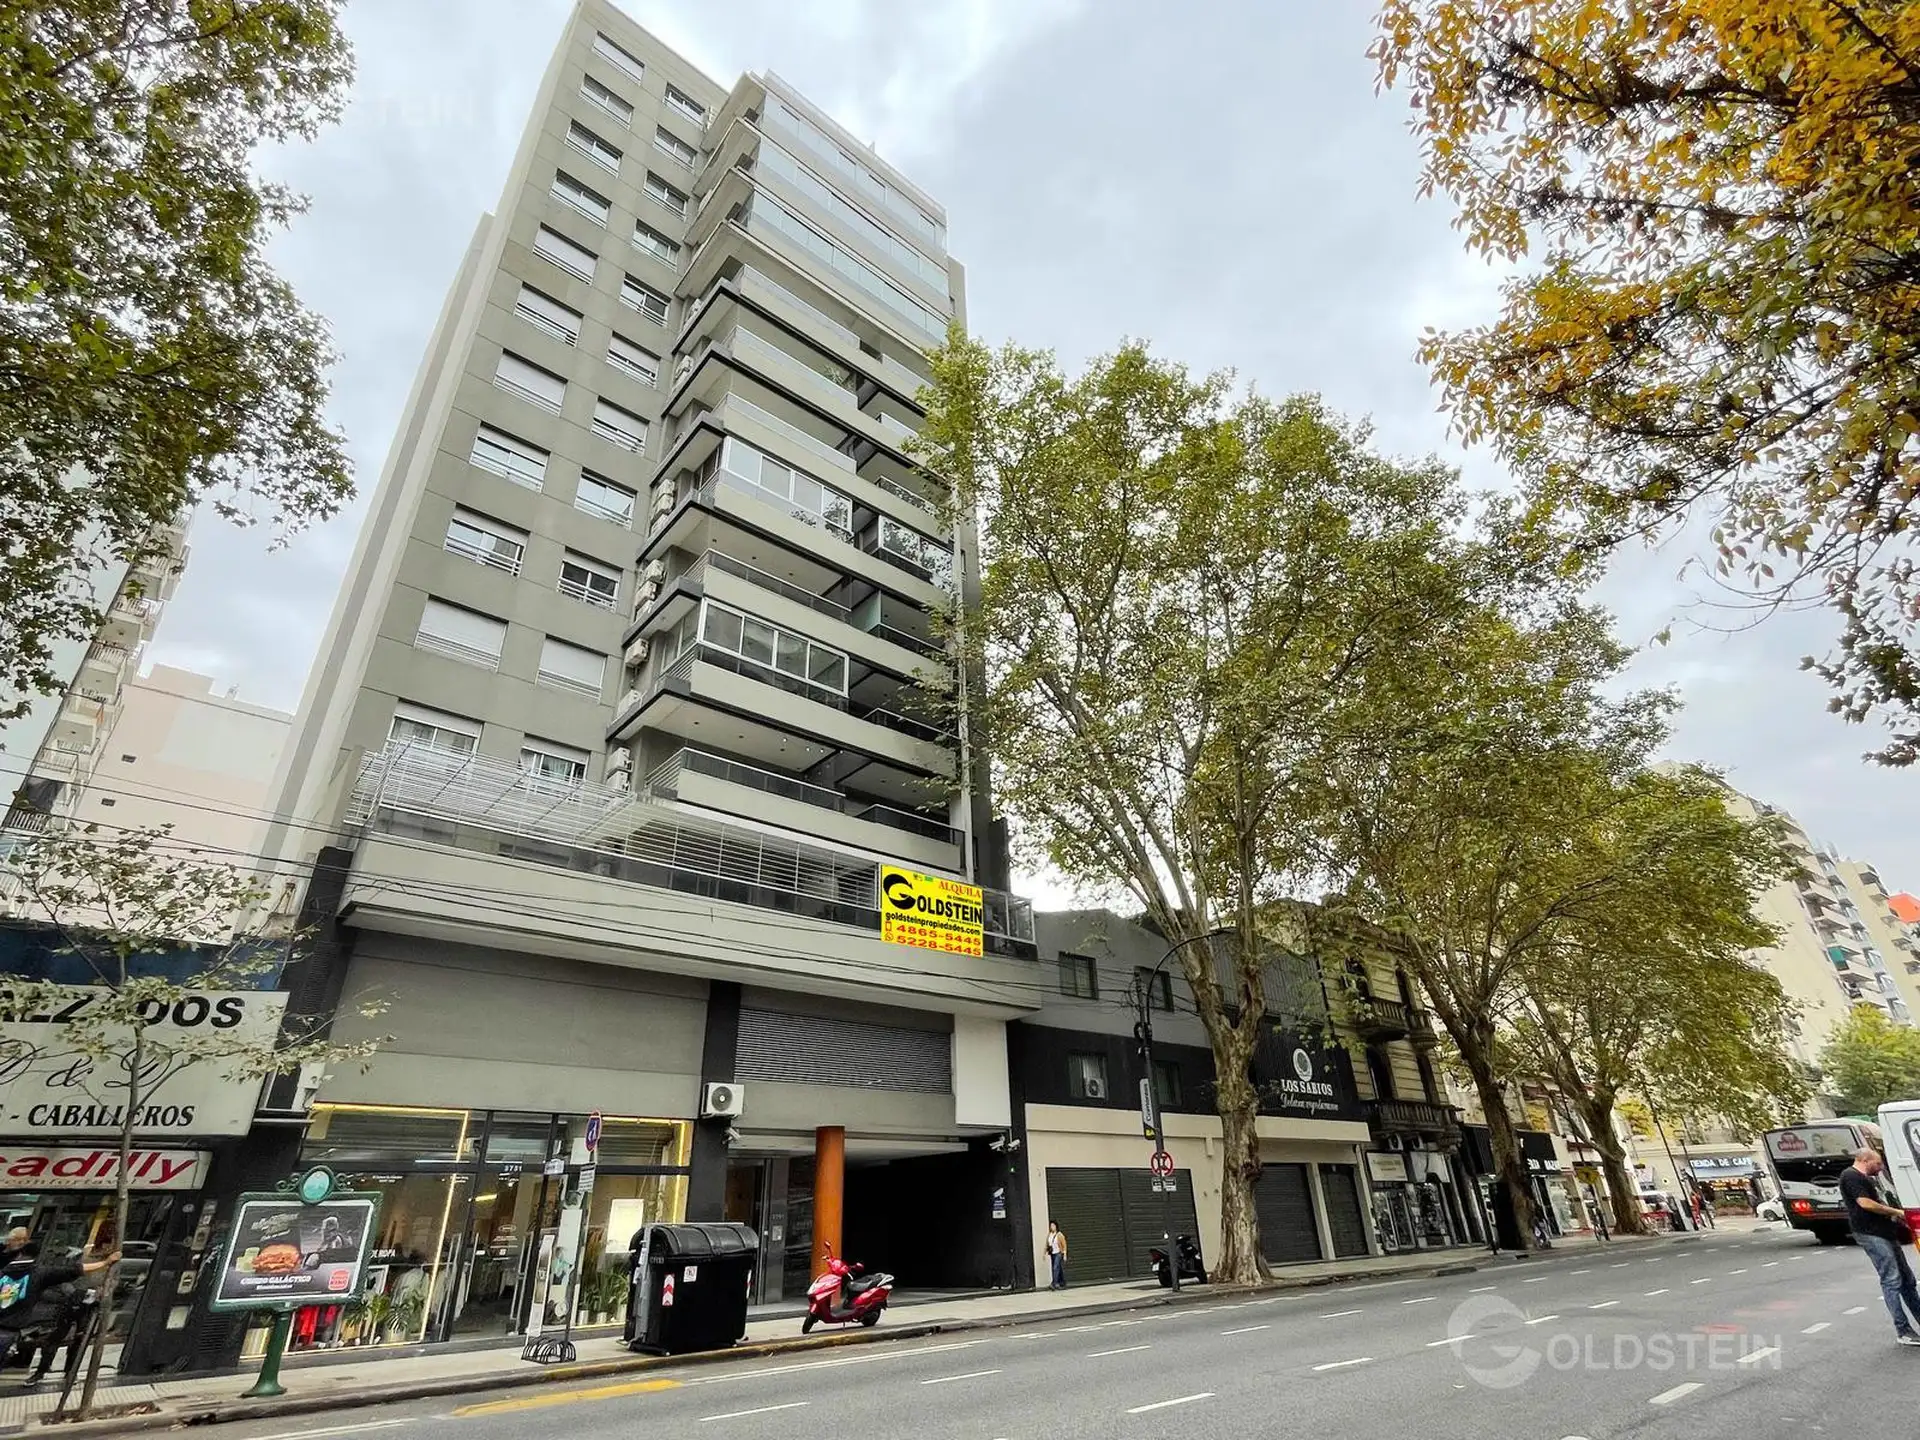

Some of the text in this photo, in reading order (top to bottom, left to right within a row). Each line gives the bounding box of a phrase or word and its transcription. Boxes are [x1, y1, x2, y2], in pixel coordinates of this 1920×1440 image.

[883, 873, 982, 924] GOLDSTEIN
[939, 881, 981, 898] ALQUILA
[896, 924, 981, 946] 4865-5445
[896, 935, 981, 956] 5228-5445
[1280, 1079, 1333, 1097] LOS SABIOS
[27, 1103, 195, 1127] CABALLEROS
[0, 1150, 197, 1184] adilly
